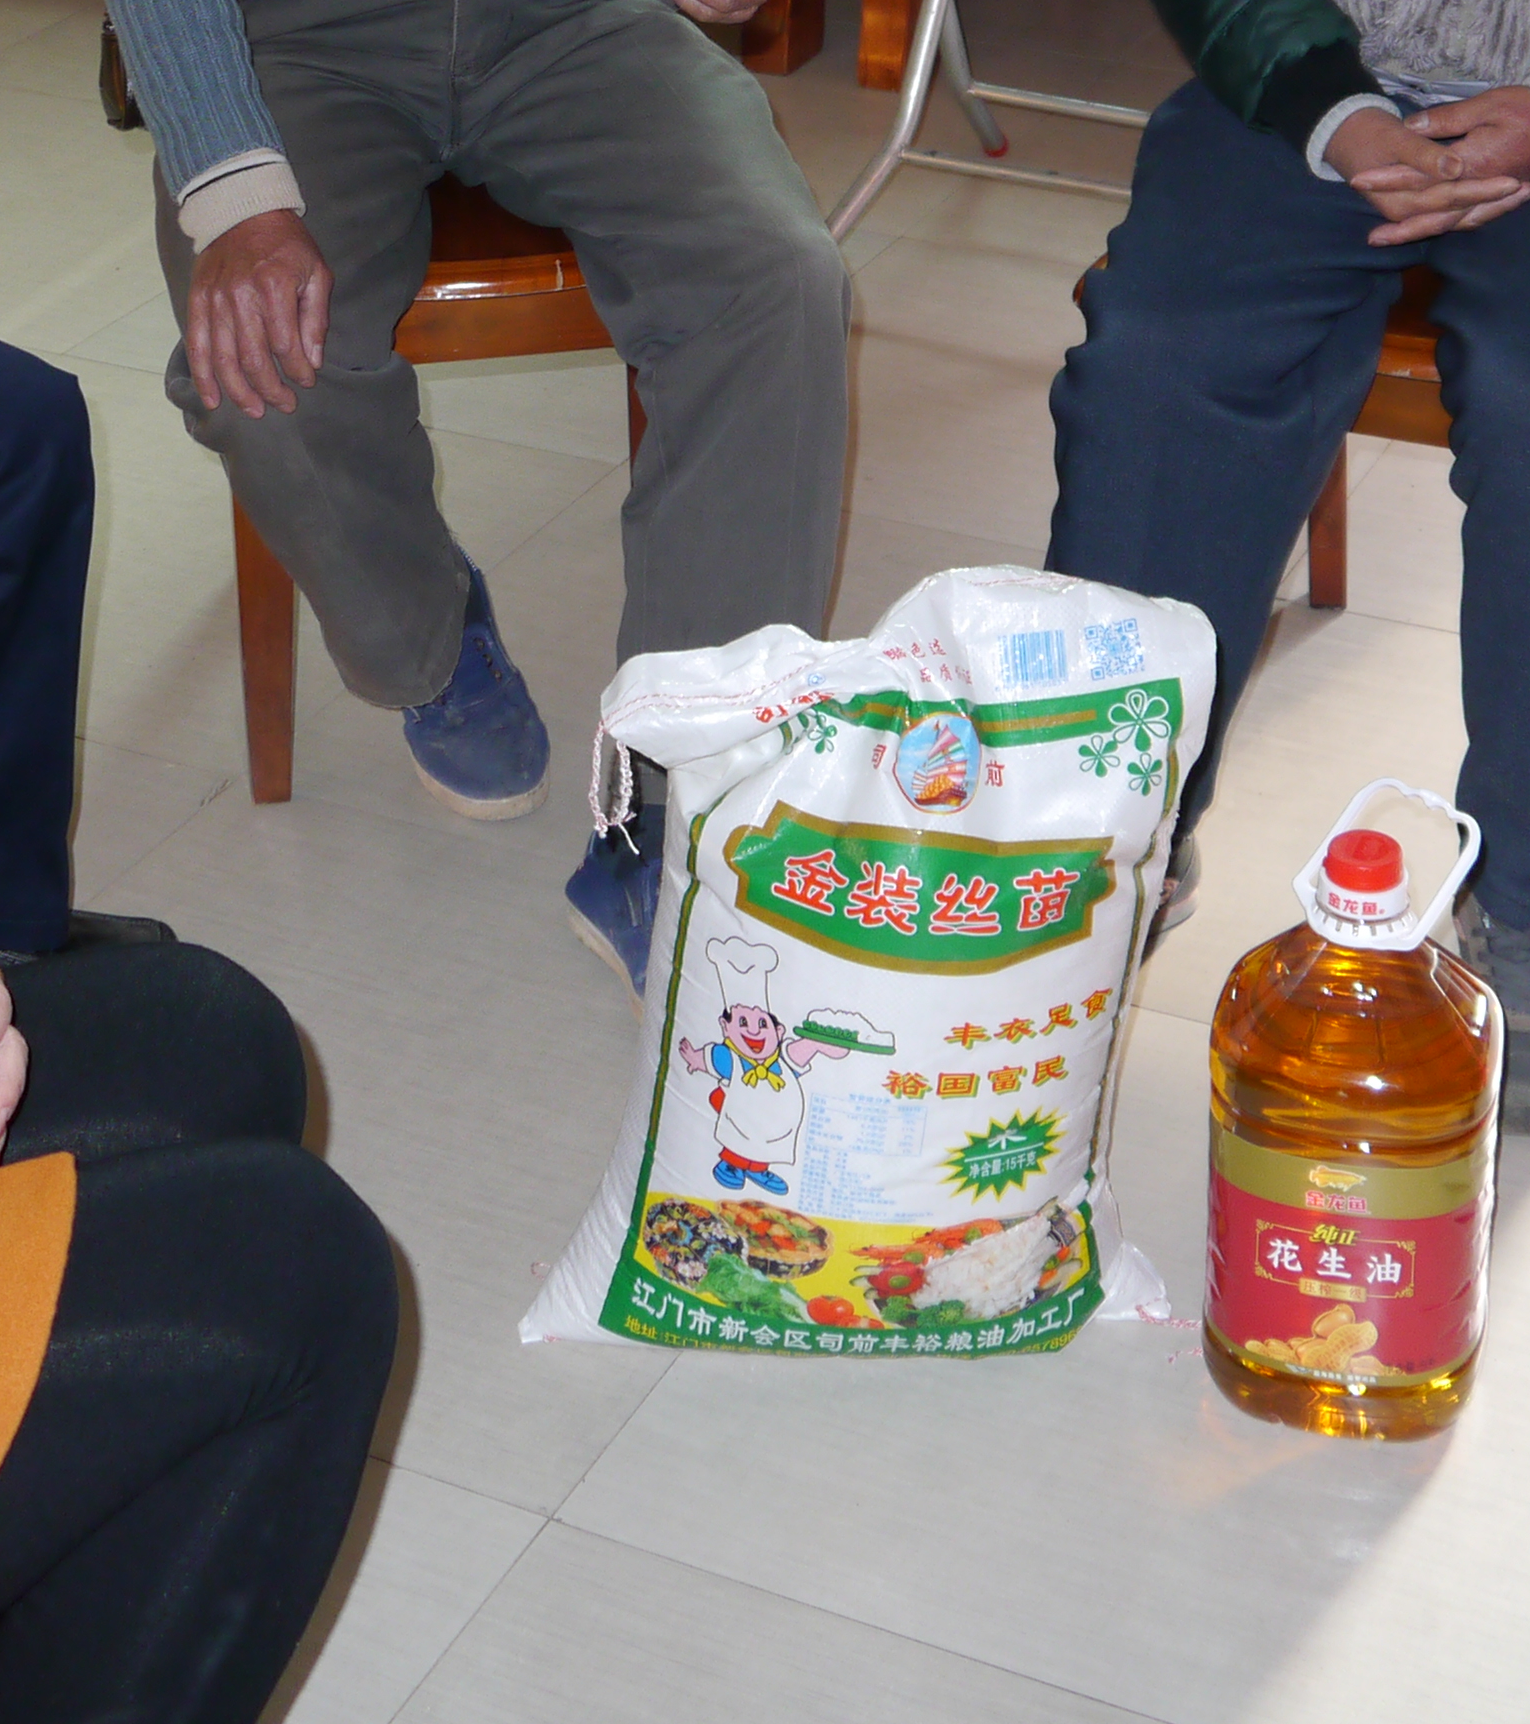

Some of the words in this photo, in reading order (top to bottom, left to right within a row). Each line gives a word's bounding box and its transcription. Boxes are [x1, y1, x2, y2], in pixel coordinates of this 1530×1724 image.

[985, 760, 1006, 788] 前
[772, 849, 1080, 935] 金装丝苗
[1328, 892, 1379, 916] 金龙鱼
[944, 987, 1112, 1049] 丰衣足食
[881, 1055, 1070, 1099] 裕国富民
[1305, 1189, 1368, 1214] 金龙鱼
[1309, 1222, 1361, 1246] 纯正
[1266, 1238, 1402, 1284] 花生油
[631, 1277, 1085, 1354] 江门市新会区司前丰裕粮油加工厂
